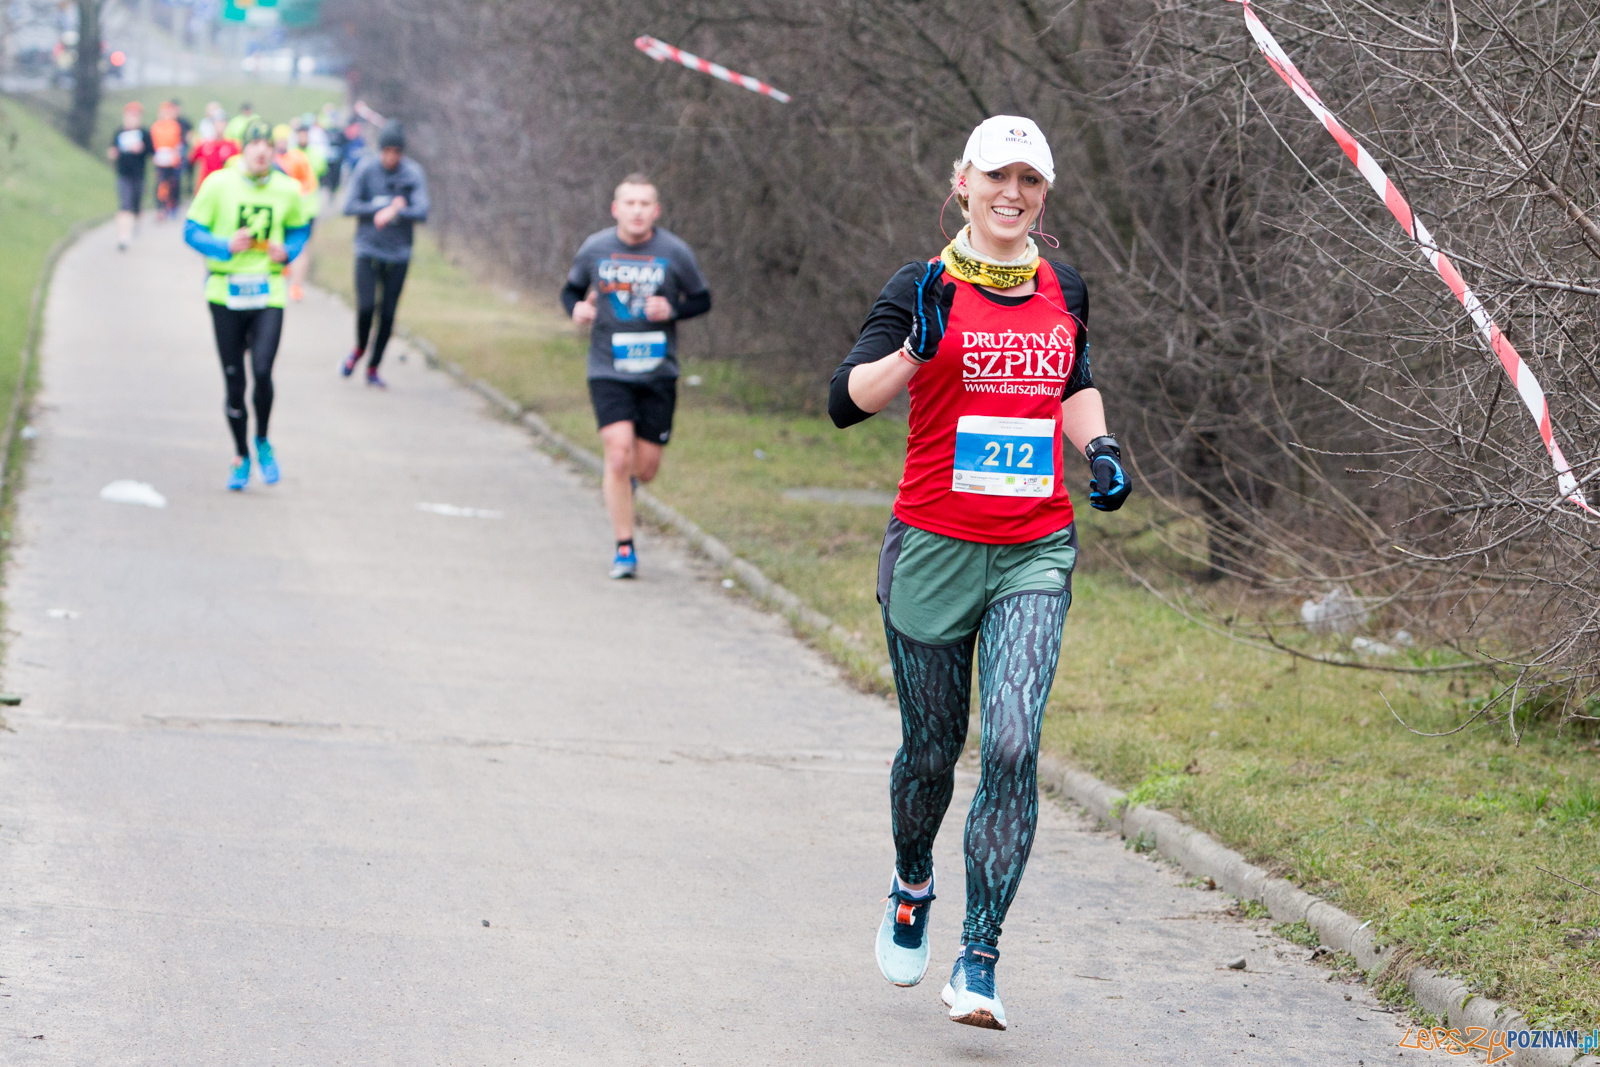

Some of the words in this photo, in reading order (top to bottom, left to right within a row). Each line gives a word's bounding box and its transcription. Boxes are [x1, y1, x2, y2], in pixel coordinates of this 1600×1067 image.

[962, 329, 1061, 349] DRUŻYNA
[962, 349, 1074, 378] SZPIKU
[965, 382, 1062, 398] www.darszpiku.pl
[982, 441, 1034, 469] 212
